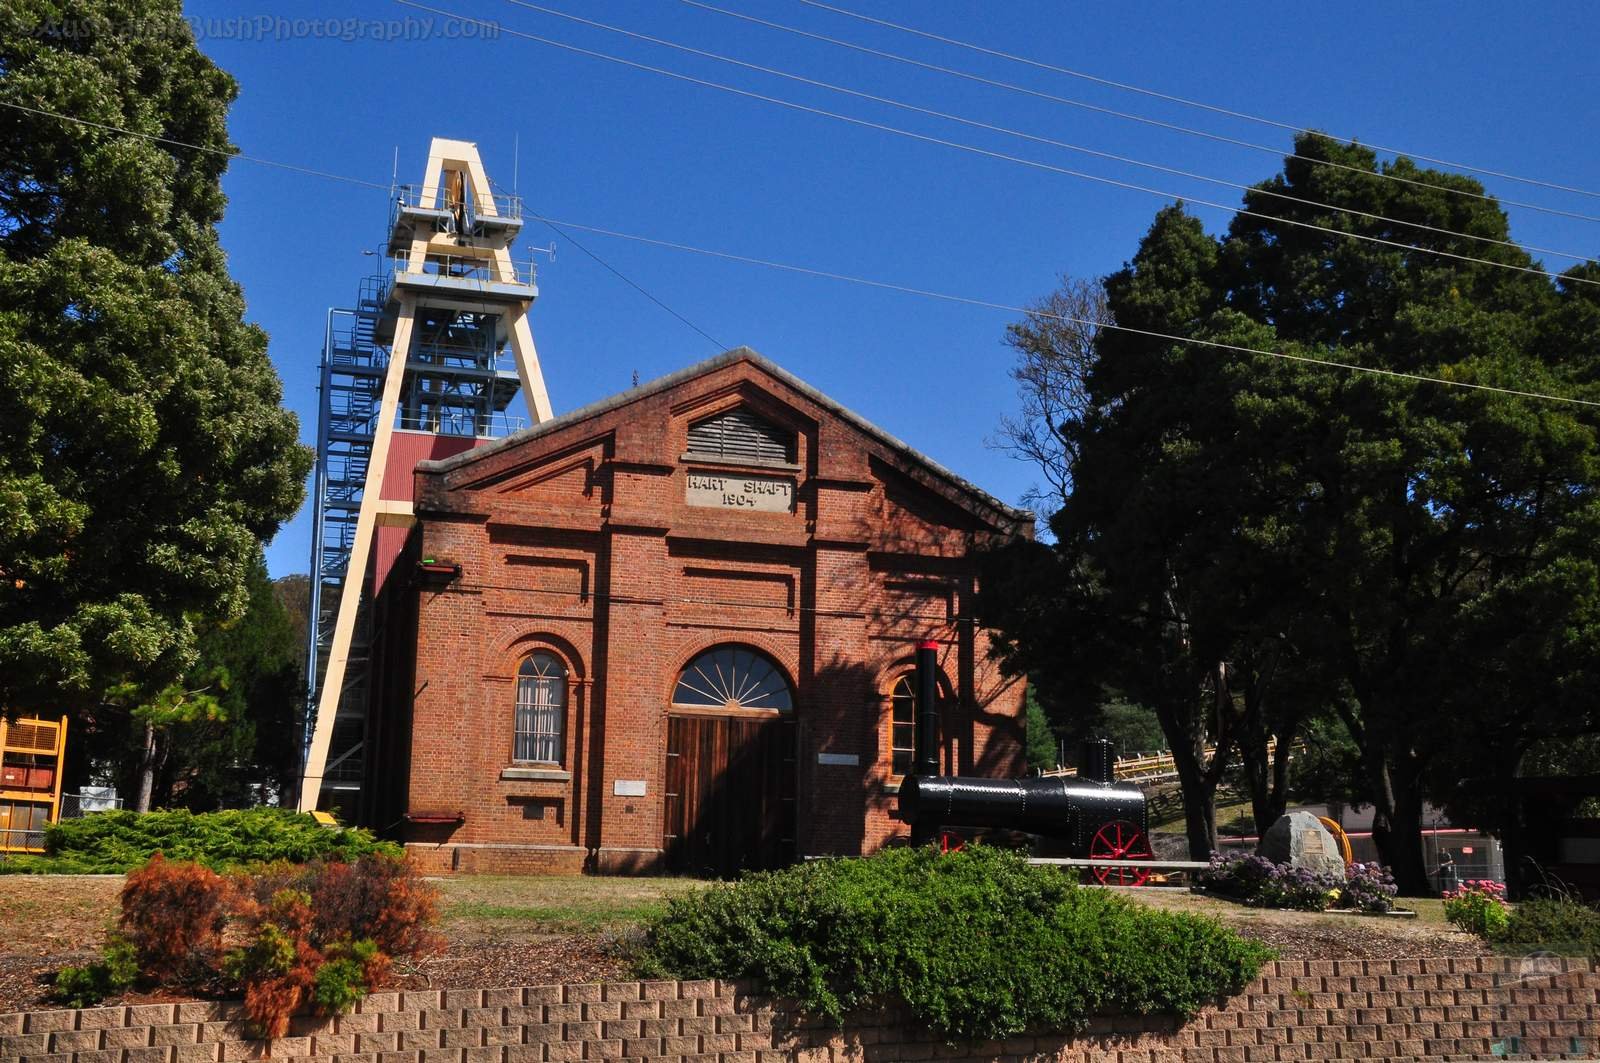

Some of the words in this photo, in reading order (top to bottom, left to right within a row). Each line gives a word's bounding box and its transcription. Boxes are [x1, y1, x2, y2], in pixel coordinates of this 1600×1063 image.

[687, 475, 727, 491] HART
[743, 480, 792, 496] SHAFT
[722, 493, 757, 507] 1904
